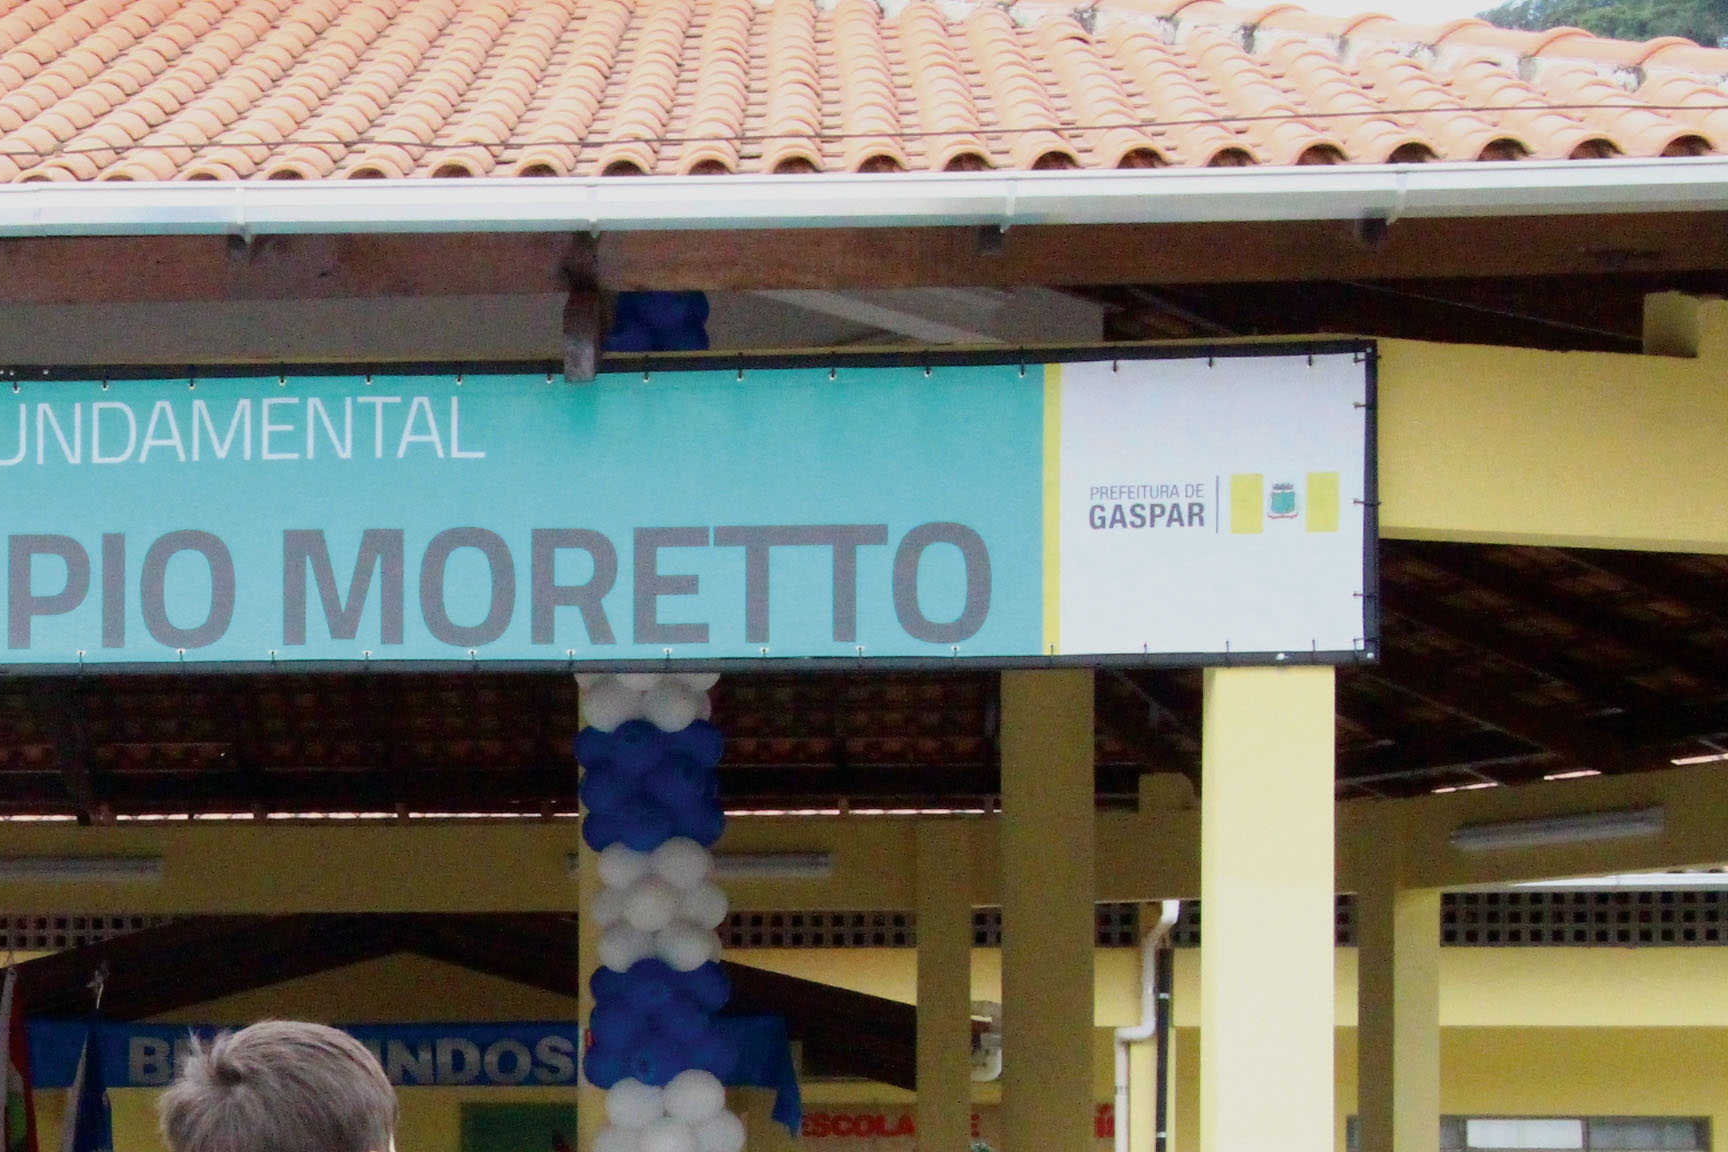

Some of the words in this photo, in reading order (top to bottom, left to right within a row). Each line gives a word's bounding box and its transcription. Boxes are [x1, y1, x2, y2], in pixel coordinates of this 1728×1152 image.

[1089, 484, 1180, 501] PREFEITURA
[1184, 483, 1205, 499] DE
[1088, 502, 1206, 530] GASPAR
[281, 520, 994, 648] MORETTO
